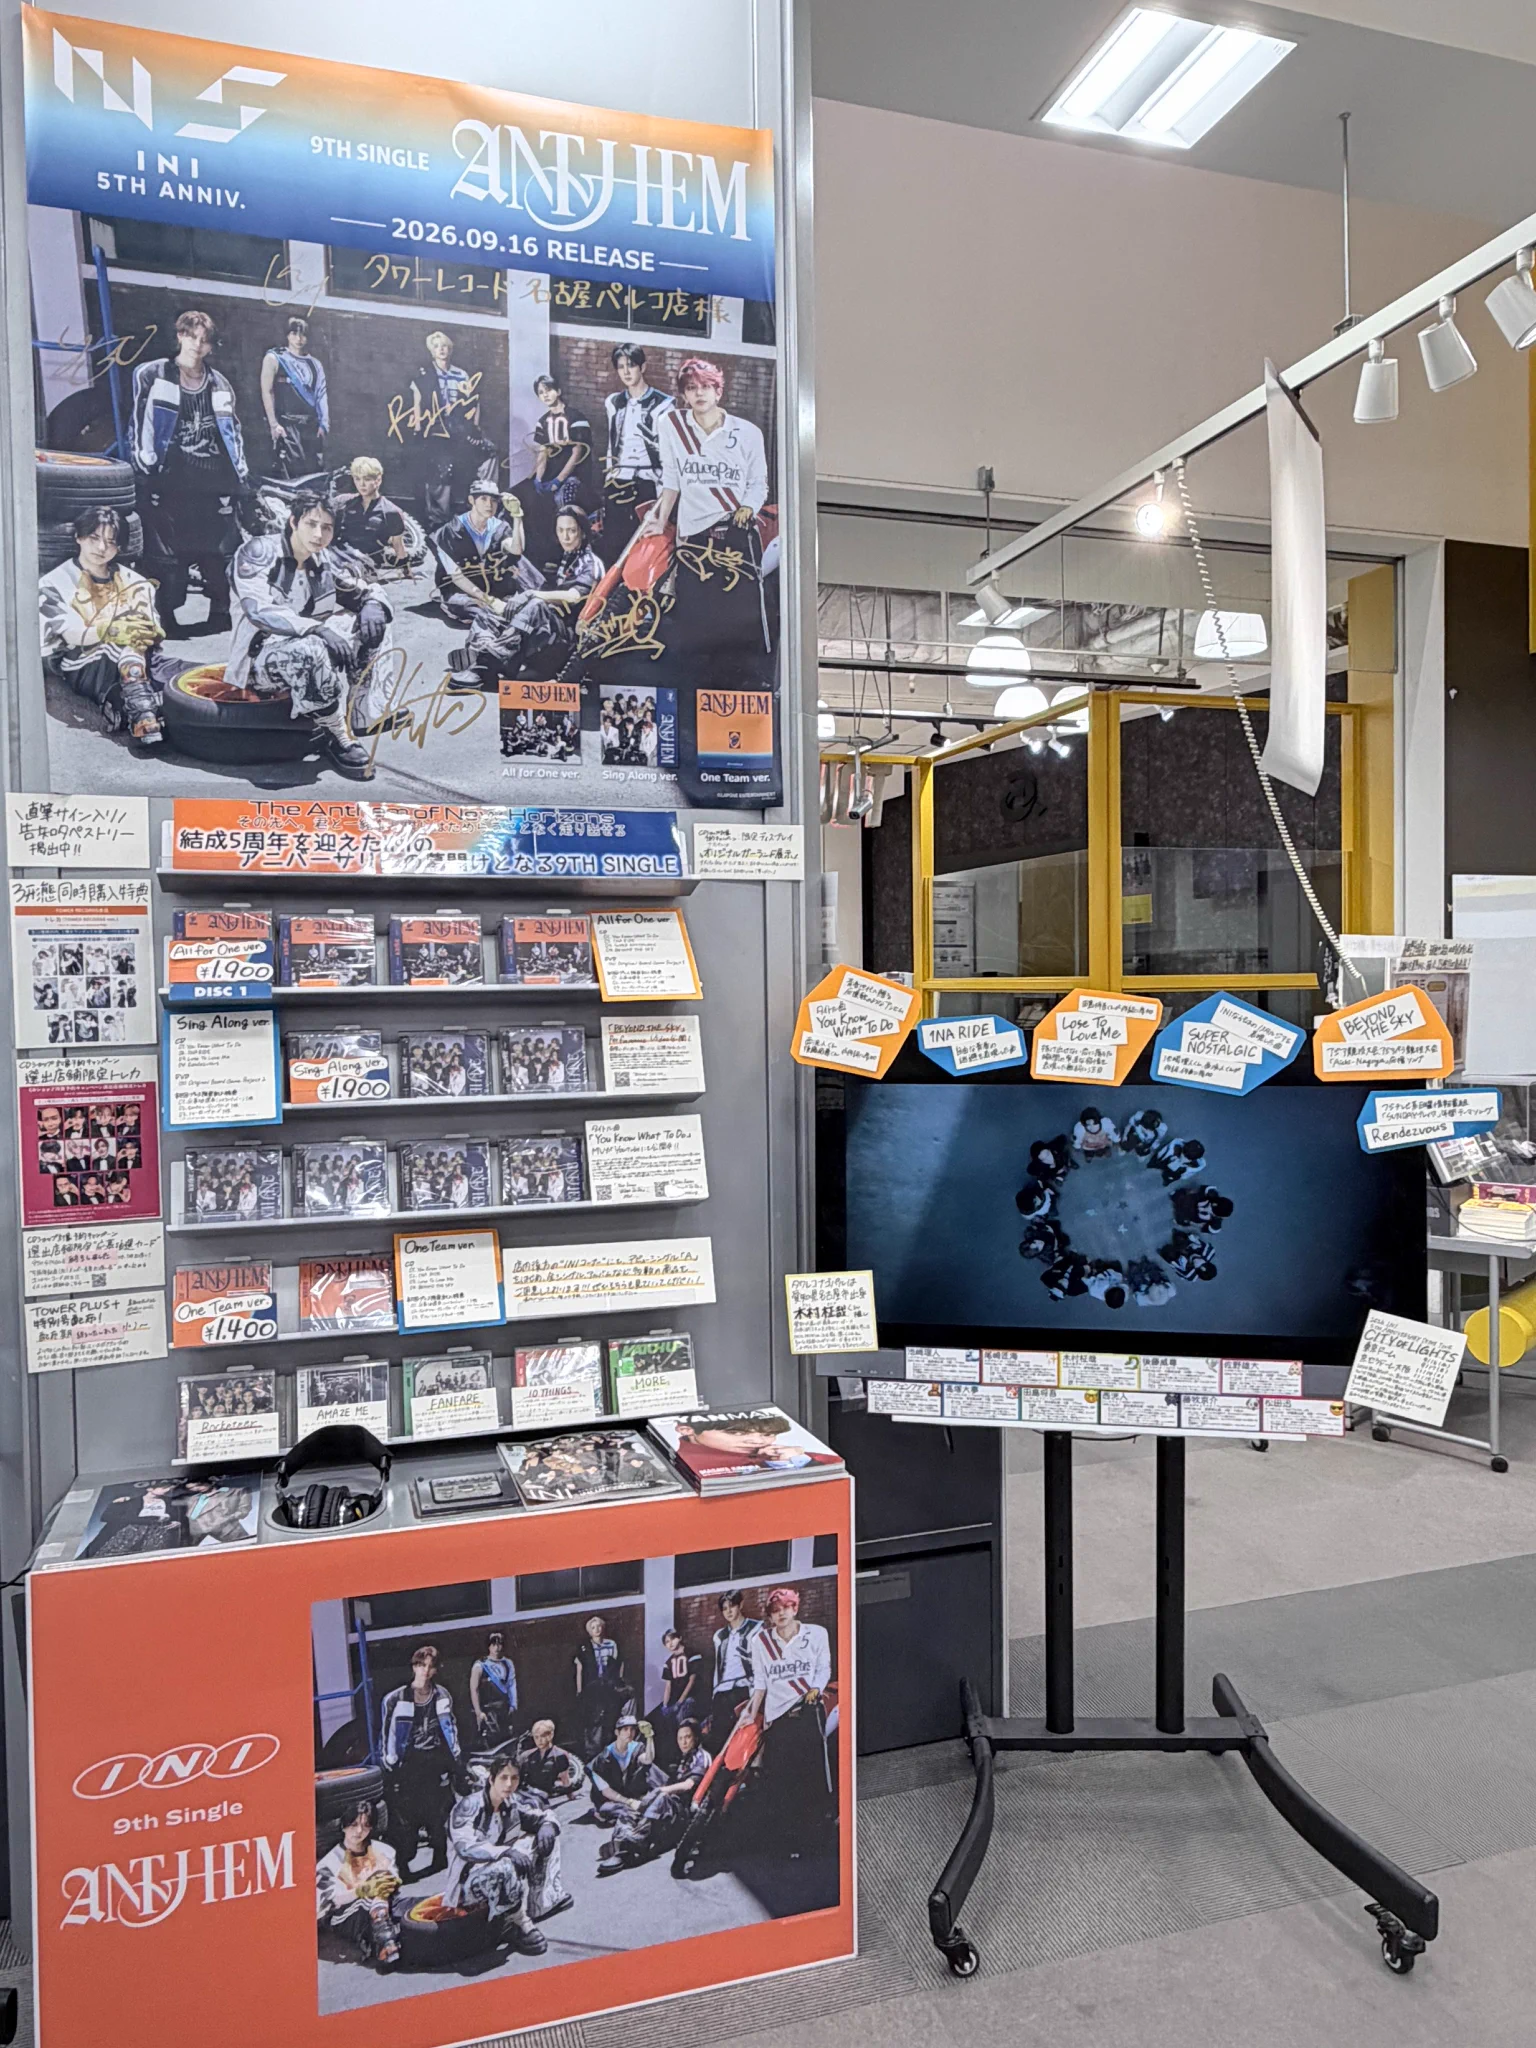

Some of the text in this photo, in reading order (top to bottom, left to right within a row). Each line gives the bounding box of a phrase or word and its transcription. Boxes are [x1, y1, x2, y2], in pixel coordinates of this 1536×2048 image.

[310, 136, 430, 171] 9TH SINGLE
[137, 150, 198, 178] INI
[450, 119, 752, 241] ANTHEM
[97, 172, 245, 209] 5TH ANNIV.
[391, 218, 655, 272] 2026.09.16 RELEASE
[520, 684, 577, 704] ANTHEM
[699, 692, 770, 717] ANTHEM
[657, 713, 676, 765] ANTHEM
[502, 767, 581, 780] All for One ver.
[602, 770, 678, 784] Sing Along ver.
[700, 772, 771, 783] One Team ver.
[250, 801, 301, 817] The
[413, 808, 441, 820] of
[509, 809, 616, 824] Horizons
[604, 855, 679, 874] SINGLE
[597, 914, 615, 925] All
[615, 914, 633, 925] for
[633, 913, 655, 924] One
[173, 944, 193, 957] All
[195, 943, 214, 956] for
[217, 942, 242, 955] One
[194, 985, 248, 997] DISC 1
[177, 1016, 207, 1031] Sing
[211, 1015, 249, 1030] Along
[816, 1013, 868, 1029] You Know
[832, 1018, 894, 1038] What To Do
[1062, 1016, 1108, 1030] Lose To
[1343, 1004, 1396, 1036] BEYOND
[1360, 1010, 1415, 1041] THE SKY
[958, 1023, 990, 1039] RIDE
[1070, 1027, 1121, 1041] Love Me
[1188, 1028, 1230, 1044] SUPER
[1187, 1041, 1258, 1058] NOSTALGIC
[294, 1063, 325, 1077] Sing
[327, 1060, 362, 1075] Along
[1371, 1122, 1448, 1143] Rendezvous
[404, 1240, 430, 1254] One
[430, 1239, 456, 1252] Team
[30, 1302, 77, 1317] TOWER
[80, 1300, 120, 1311] PLUS+
[178, 1305, 205, 1320] One
[208, 1301, 243, 1314] Team
[1364, 1329, 1459, 1363] CITY OF LIGHTS
[635, 1375, 668, 1388] MORE
[430, 1392, 480, 1408] FANFARE
[540, 1386, 573, 1399] THINGS
[354, 1405, 369, 1416] ME
[202, 1419, 259, 1432] Rocketeer
[670, 1658, 687, 1679] 10
[100, 1742, 253, 1791] INI
[113, 1800, 244, 1835] 9th Single
[60, 1830, 297, 1931] ANTHEM
